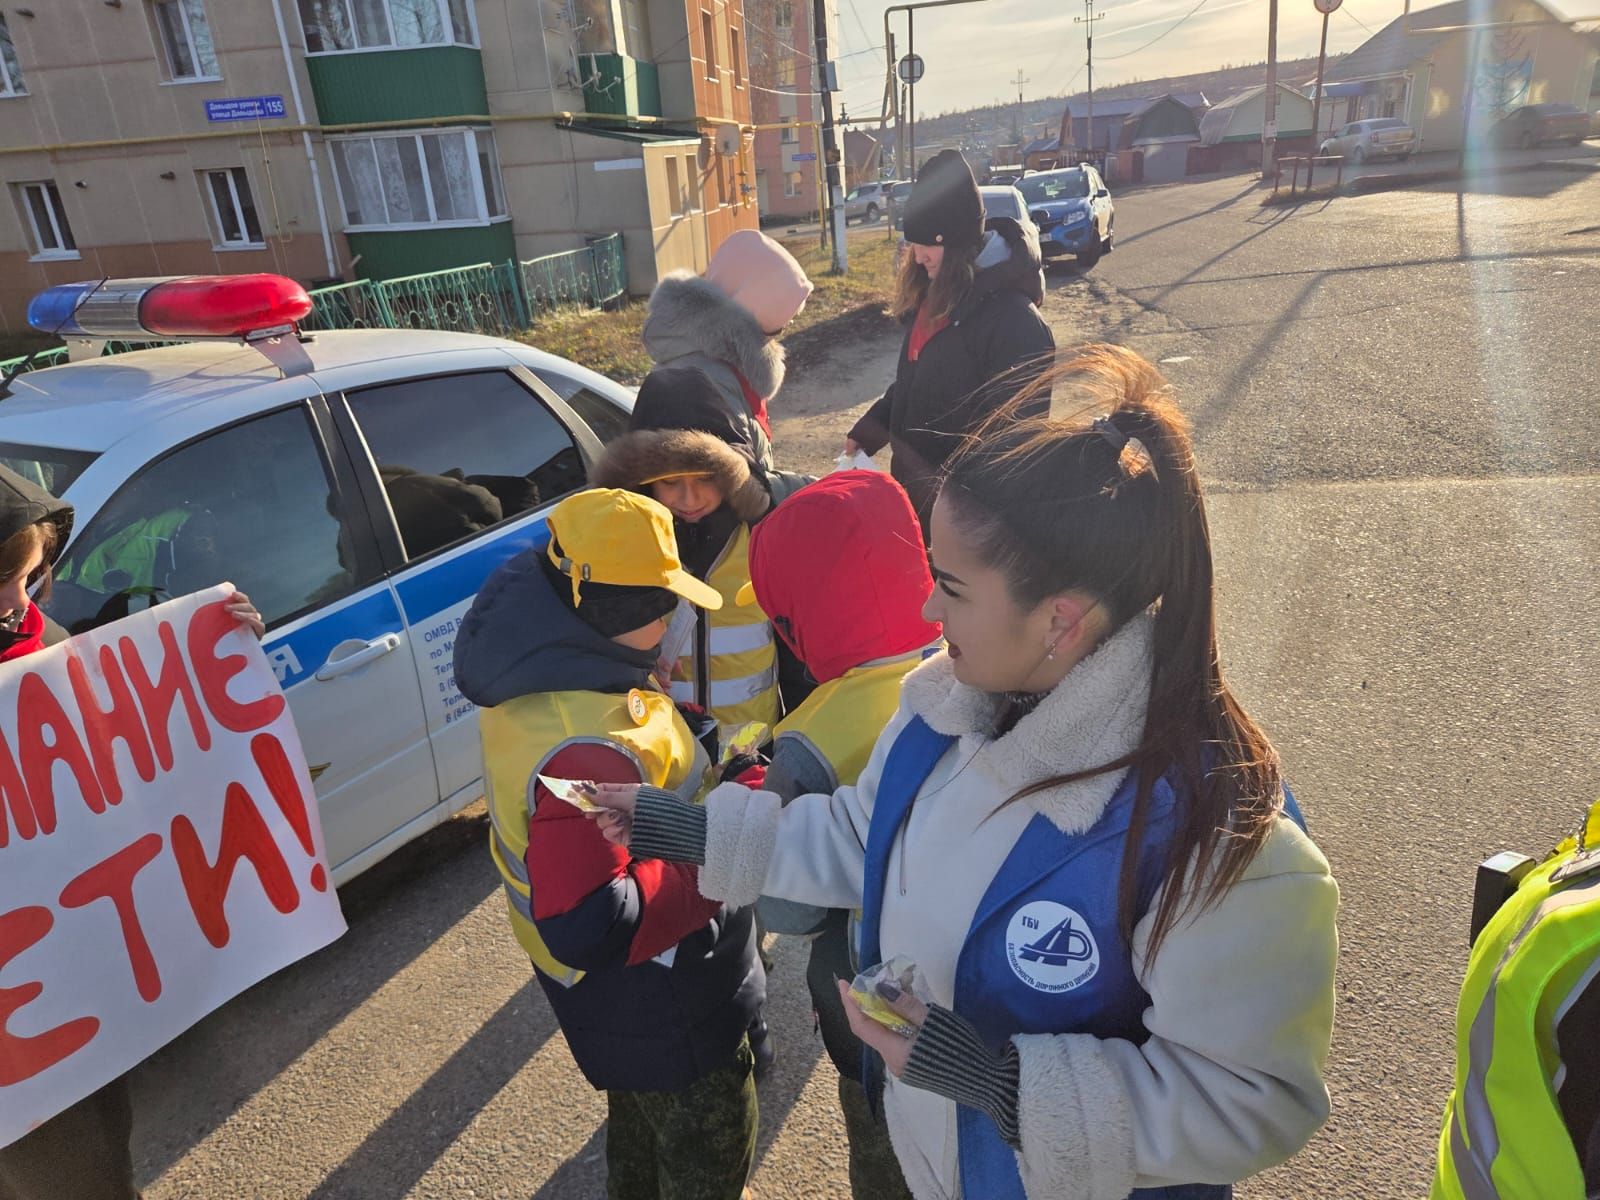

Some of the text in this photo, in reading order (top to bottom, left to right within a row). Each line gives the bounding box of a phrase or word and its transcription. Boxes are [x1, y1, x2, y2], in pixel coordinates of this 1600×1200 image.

[266, 101, 283, 113] 155
[424, 621, 456, 642] ОМВД
[430, 648, 443, 660] по
[1021, 915, 1040, 930] ГБУ
[1008, 942, 1036, 985] БЕЗОПАСНОСТЬ
[1035, 981, 1075, 992] ДОРОЖНОГО
